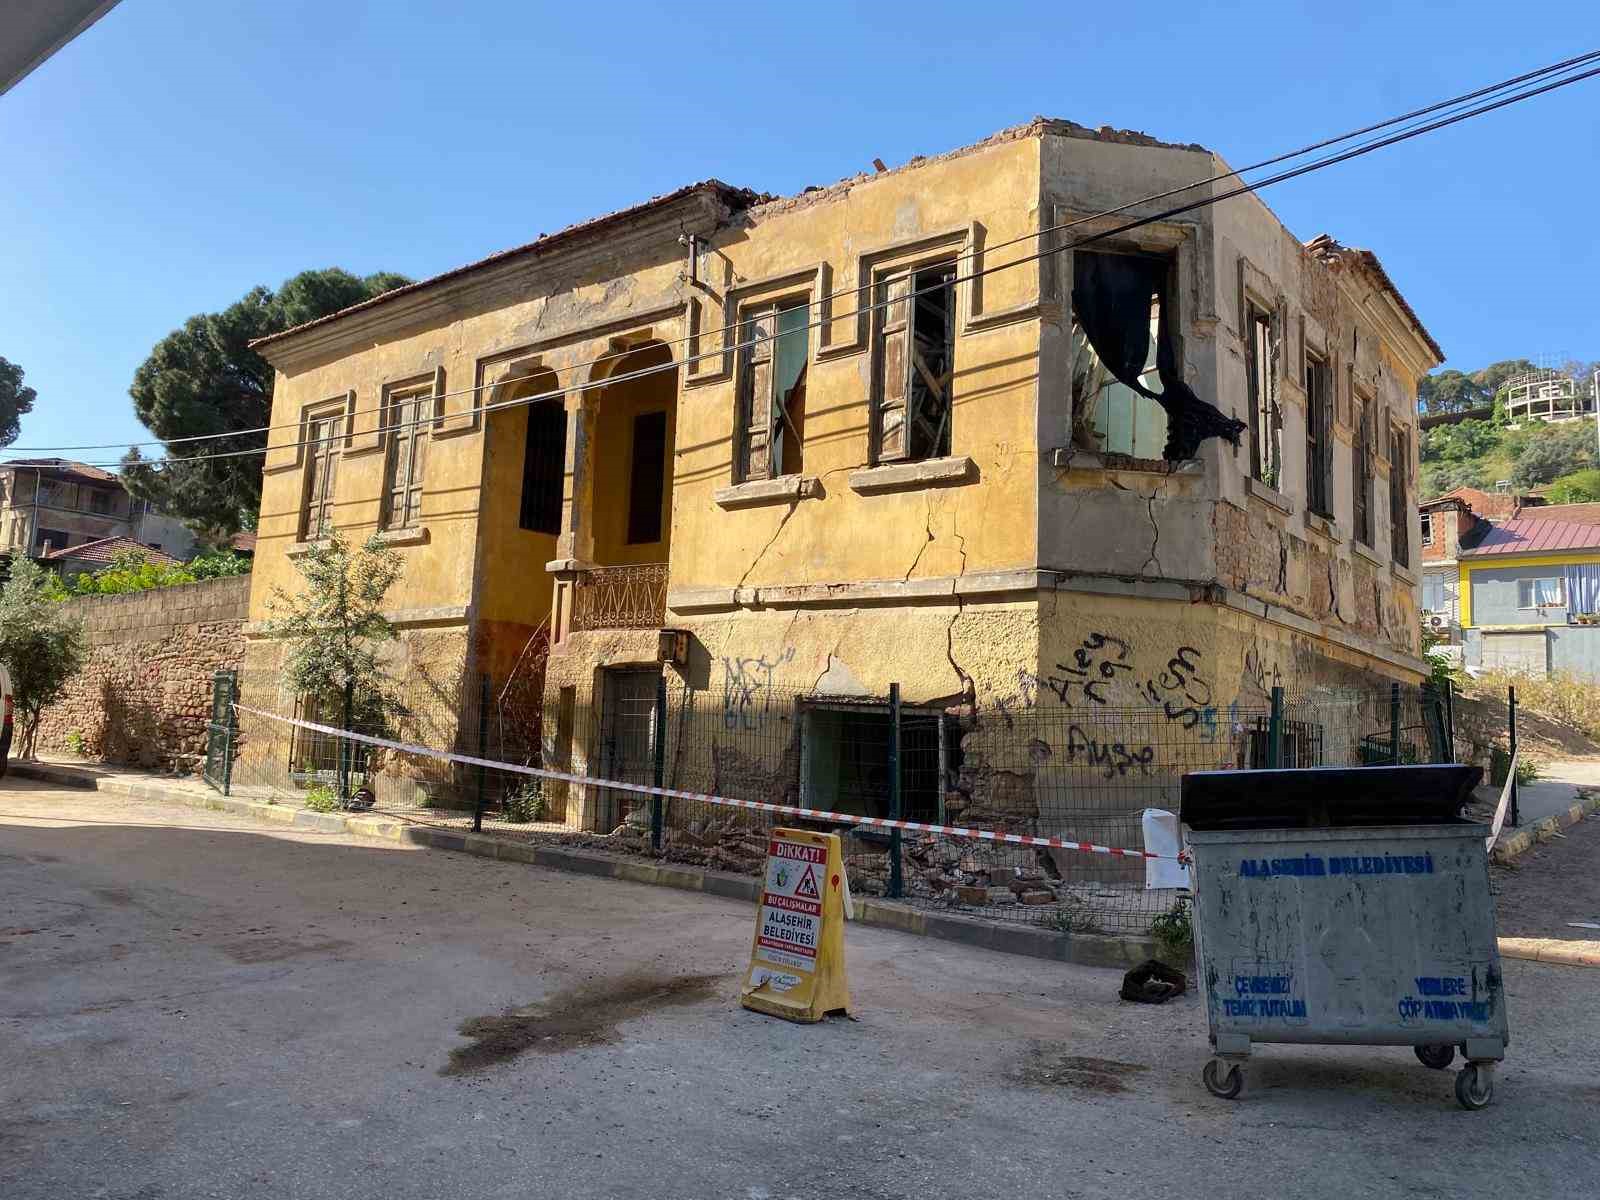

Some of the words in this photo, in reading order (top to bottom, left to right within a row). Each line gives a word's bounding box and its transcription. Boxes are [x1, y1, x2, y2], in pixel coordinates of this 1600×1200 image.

[1328, 851, 1434, 876] BELEDİYESİ
[778, 896, 818, 913] ÇALIŞMALAR
[769, 911, 813, 930] ALAŞEHİR
[763, 925, 816, 946] BELEDİYESİ
[1414, 976, 1466, 996] YEERE
[1398, 996, 1422, 1022] ÇÖP
